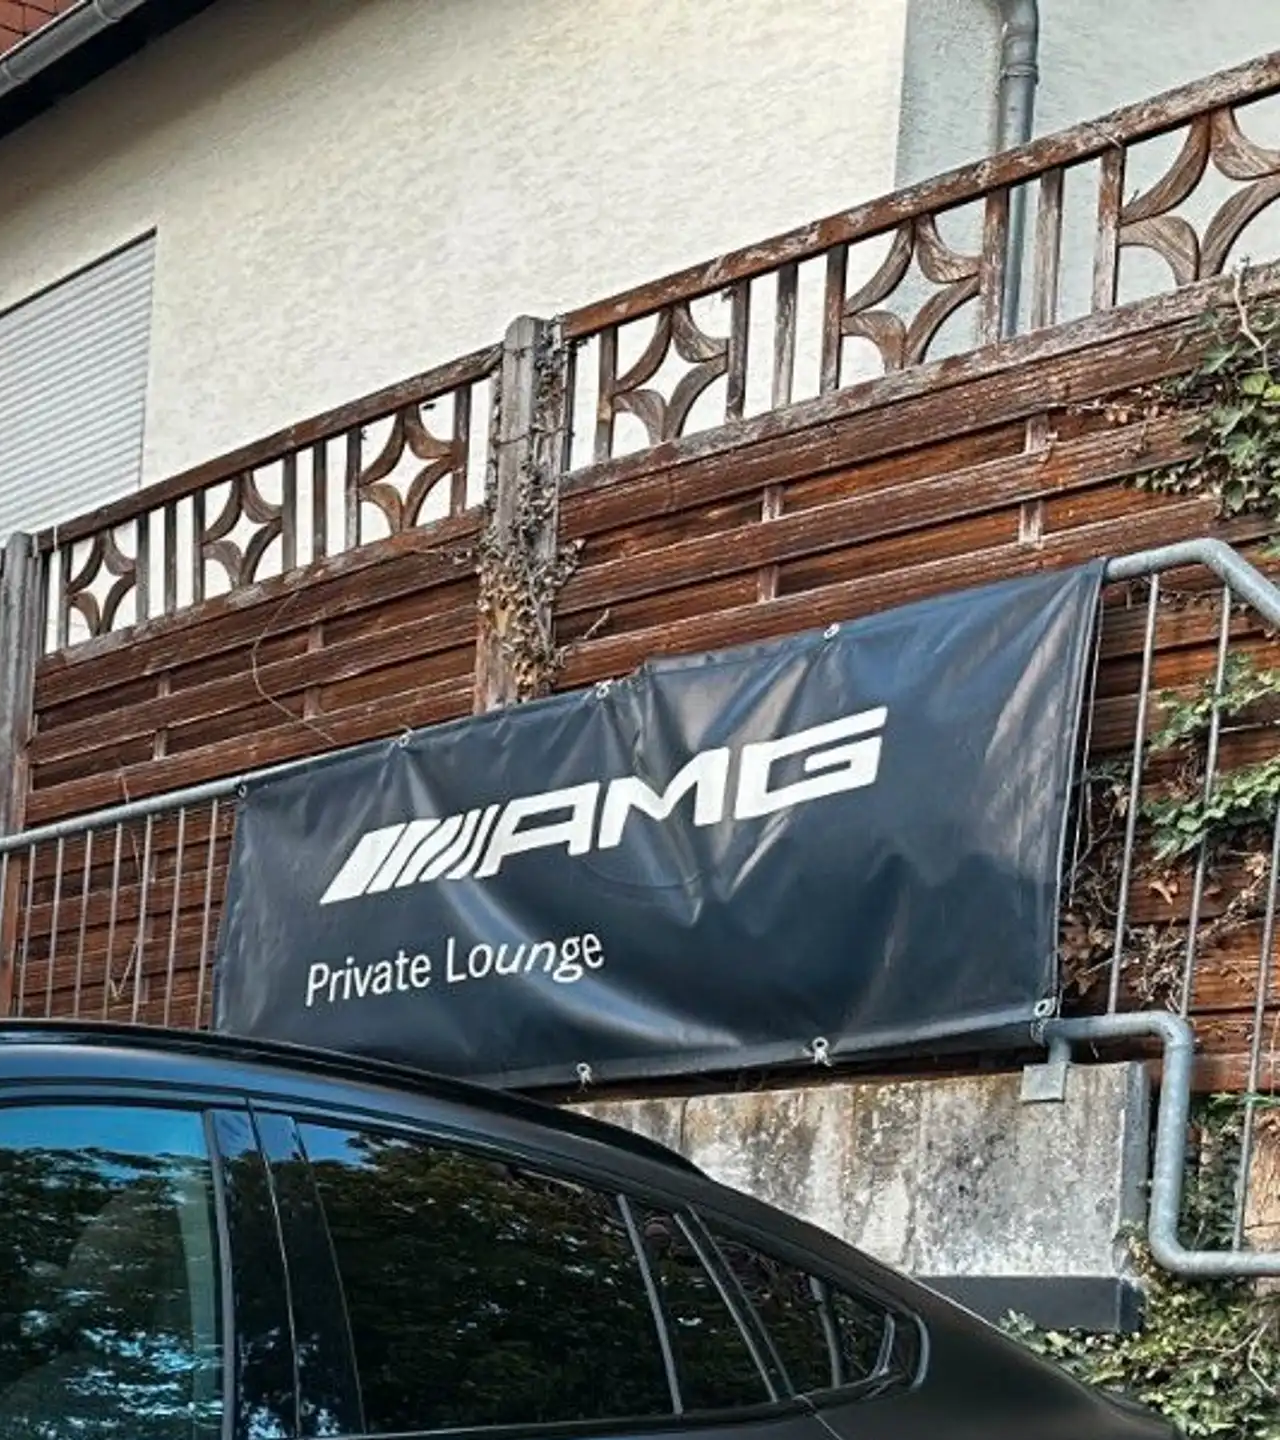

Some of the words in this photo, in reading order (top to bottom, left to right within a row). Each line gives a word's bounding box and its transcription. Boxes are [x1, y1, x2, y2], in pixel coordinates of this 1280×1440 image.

[474, 706, 888, 879] AMG
[306, 950, 432, 1007] Private
[446, 932, 605, 984] Lounge
